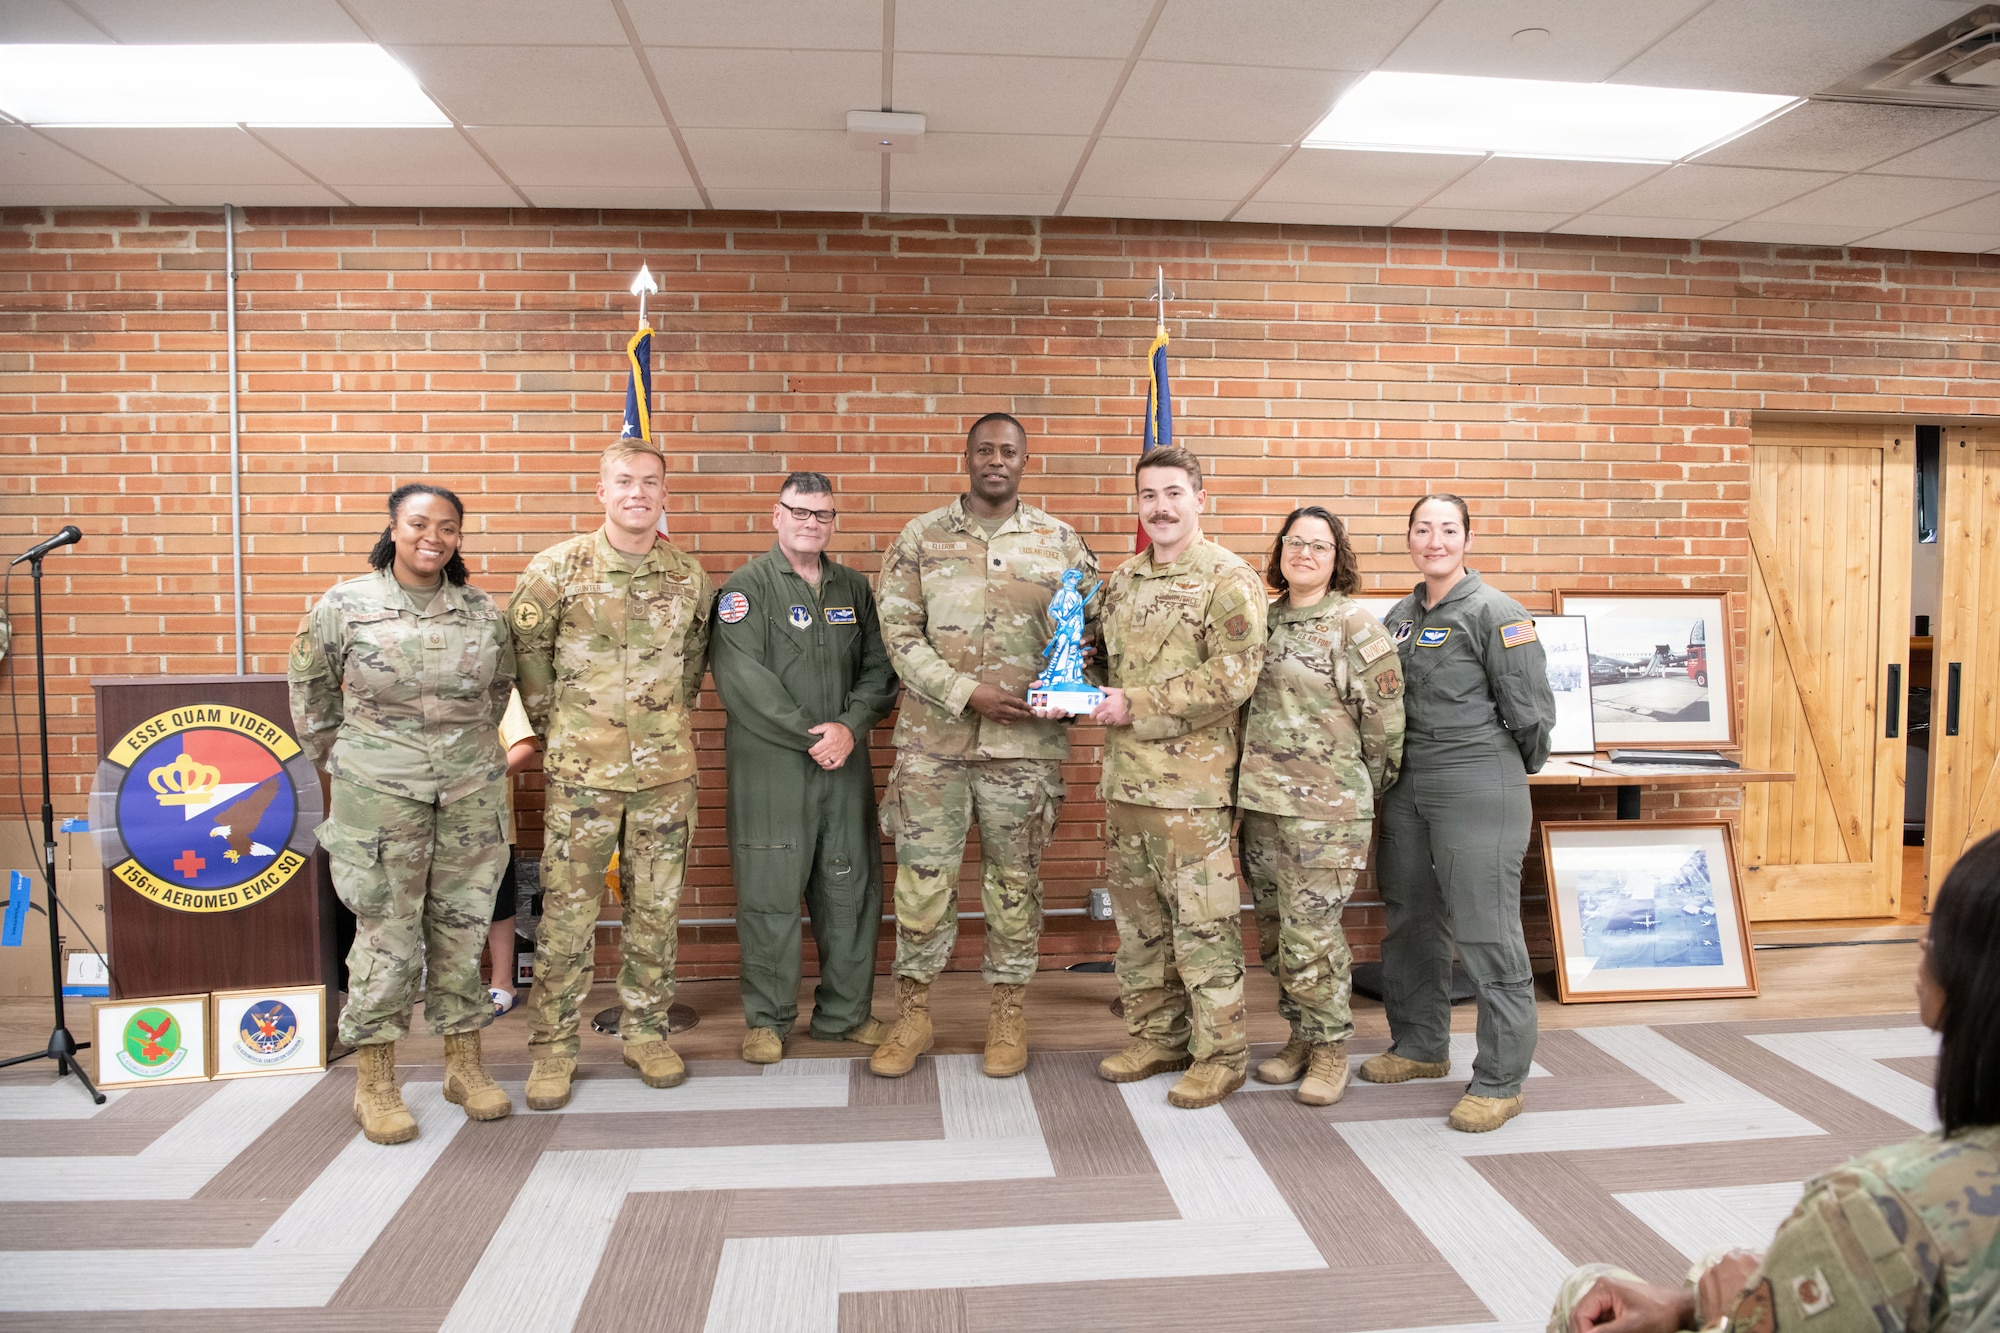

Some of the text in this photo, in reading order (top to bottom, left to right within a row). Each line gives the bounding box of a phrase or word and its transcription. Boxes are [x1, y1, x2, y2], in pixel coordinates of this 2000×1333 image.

[1034, 547, 1043, 555] AIR
[1044, 549, 1060, 560] FORCE
[574, 584, 602, 593] GUNTER
[1179, 595, 1198, 606] FORCE
[1308, 635, 1318, 643] AIR
[127, 709, 283, 750] ESSE QUAM VIDERI
[121, 855, 301, 908] 156TH AEROMED EVAC SQ
